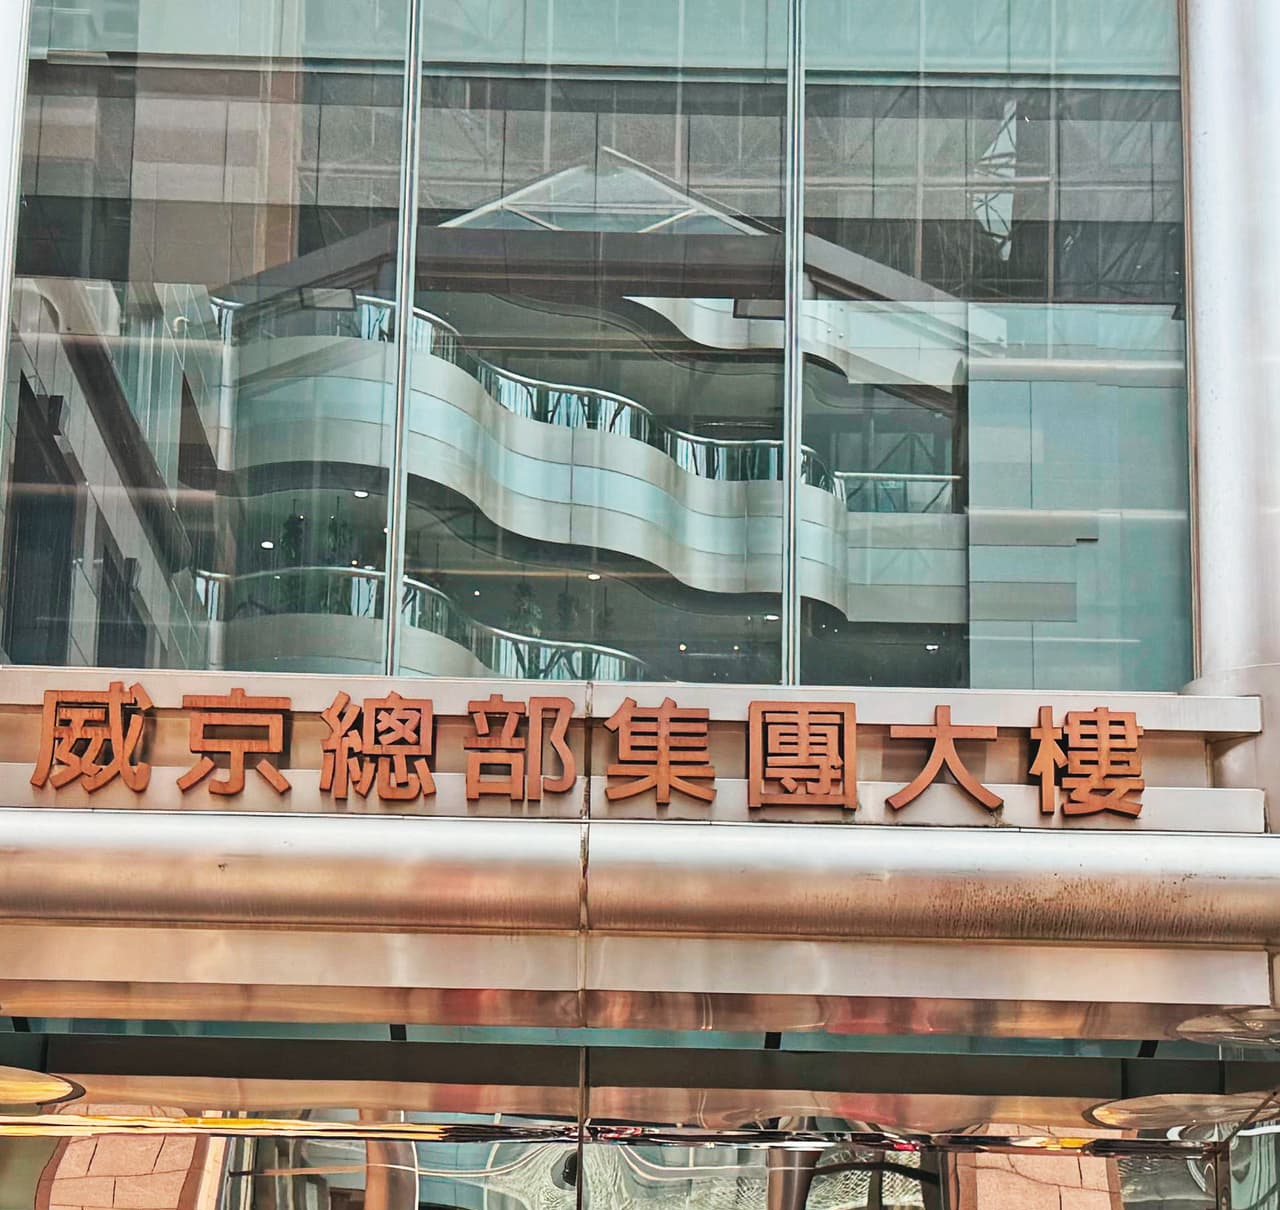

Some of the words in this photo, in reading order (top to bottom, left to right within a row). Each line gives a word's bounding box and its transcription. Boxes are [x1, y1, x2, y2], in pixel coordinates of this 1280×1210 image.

[29, 680, 1145, 820] 威京總部集團大樓
